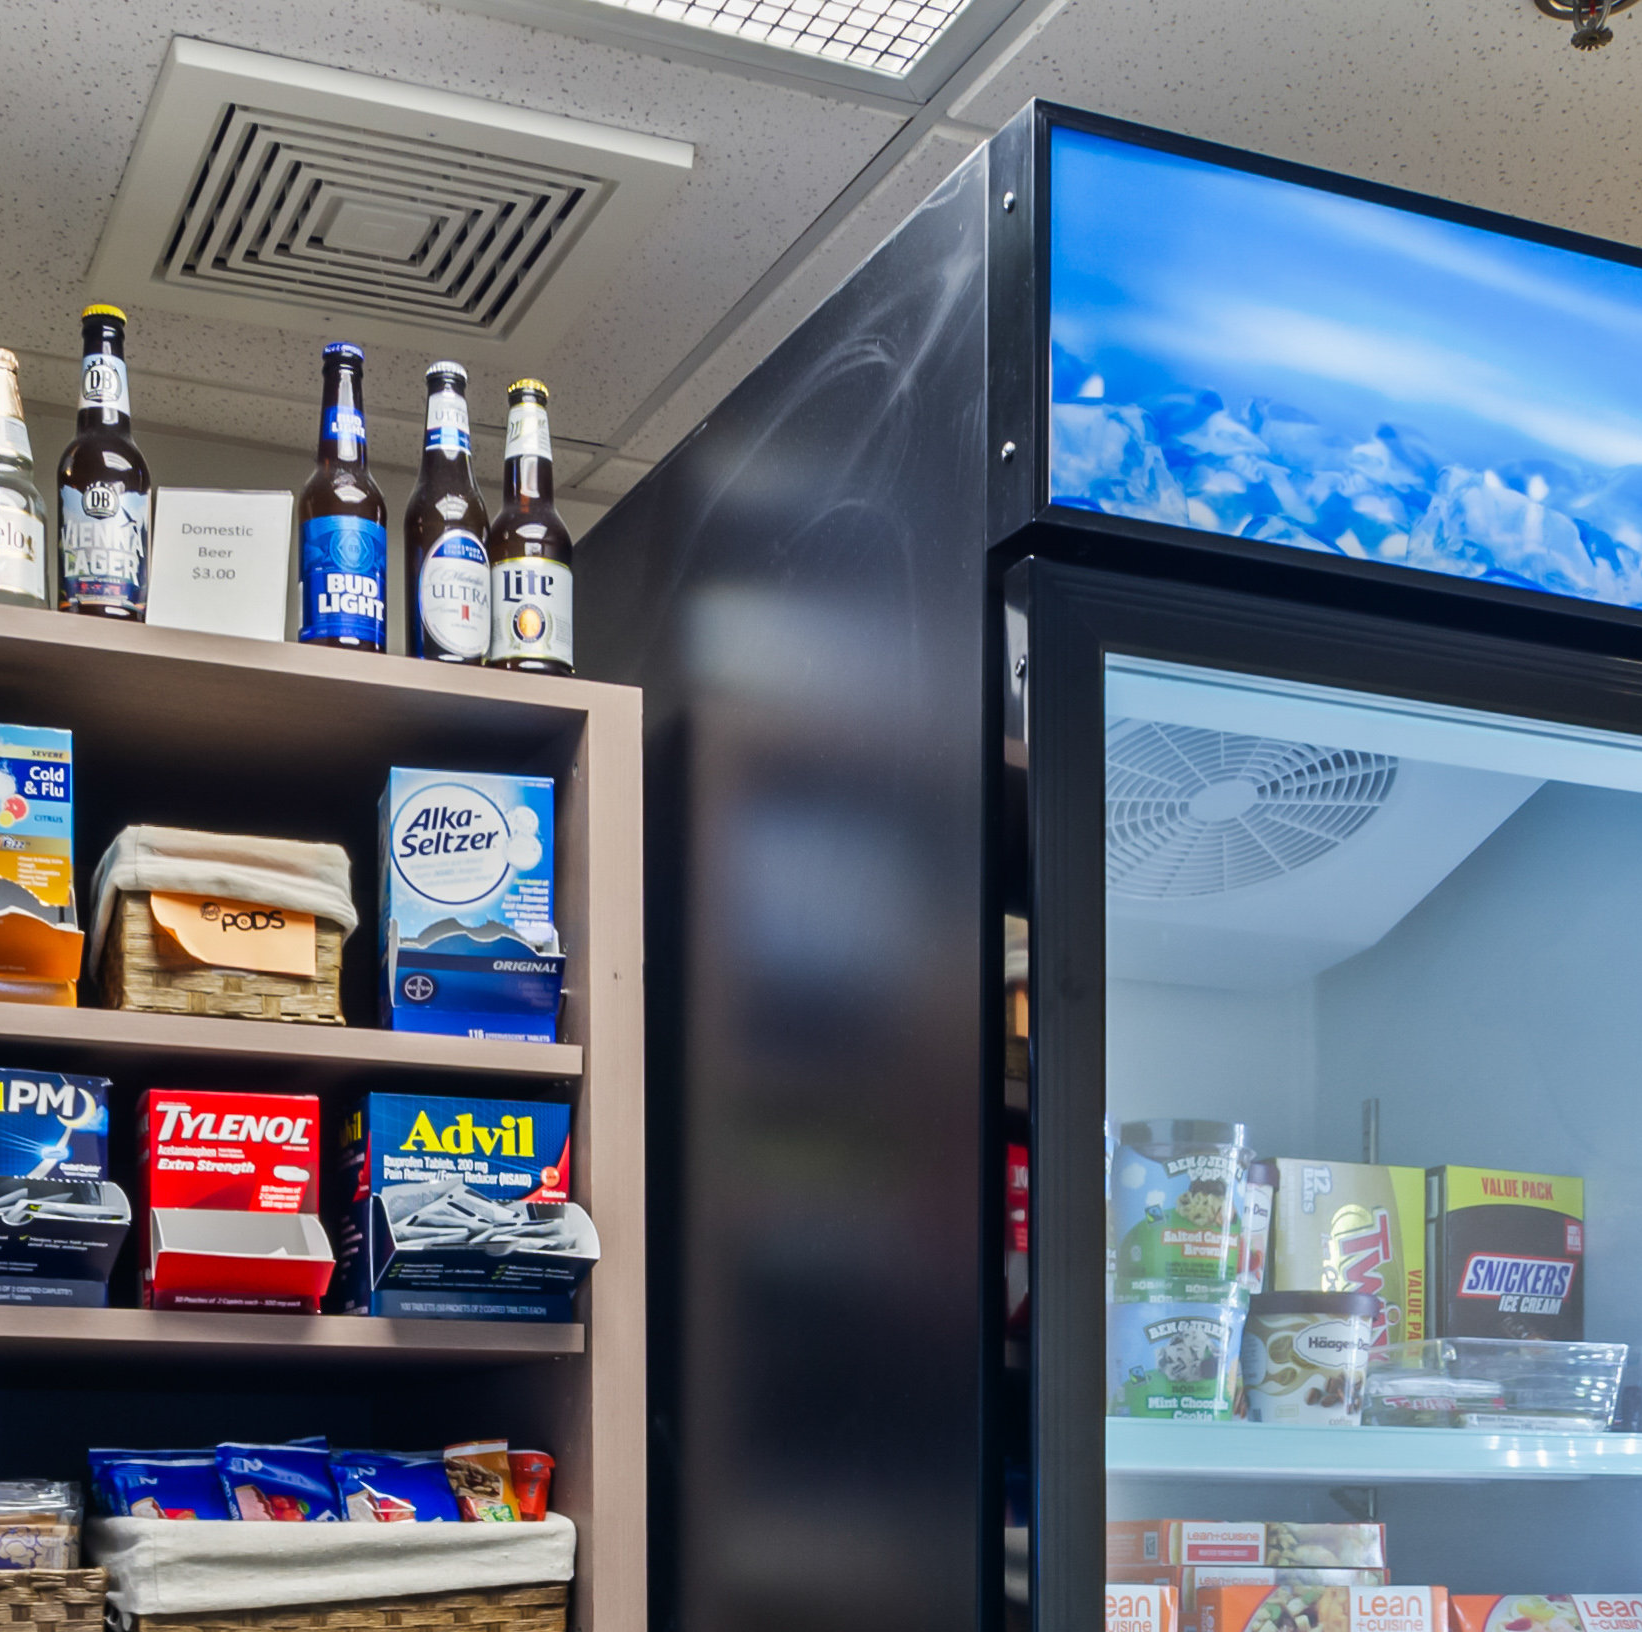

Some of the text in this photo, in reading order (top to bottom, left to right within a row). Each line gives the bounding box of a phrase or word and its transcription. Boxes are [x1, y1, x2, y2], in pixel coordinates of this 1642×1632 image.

[61, 521, 144, 558] VIENNA
[181, 522, 253, 538] Domestic
[197, 546, 233, 560] Beer
[62, 551, 139, 587] LAGER
[191, 565, 236, 582] $3.00
[326, 573, 378, 597] BUD
[502, 561, 555, 602] Lite
[432, 583, 489, 606] ULTRA
[318, 591, 385, 623] LIGHT
[29, 766, 64, 782] Cold
[24, 781, 64, 797] & Flu
[406, 806, 482, 832] Alka-
[399, 830, 499, 858] Seltzer
[221, 909, 285, 932] PODS
[493, 960, 557, 974] ORIGINAL
[8, 1079, 76, 1117] PM
[156, 1104, 310, 1145] TYLENOL
[400, 1110, 535, 1157] Advil
[157, 1158, 255, 1174] Extra Strength
[1481, 1177, 1554, 1200] VALUE PACK
[1466, 1258, 1571, 1296] SNICKERS
[1498, 1295, 1563, 1315] ICE CREAM
[1358, 1595, 1423, 1617] Lean
